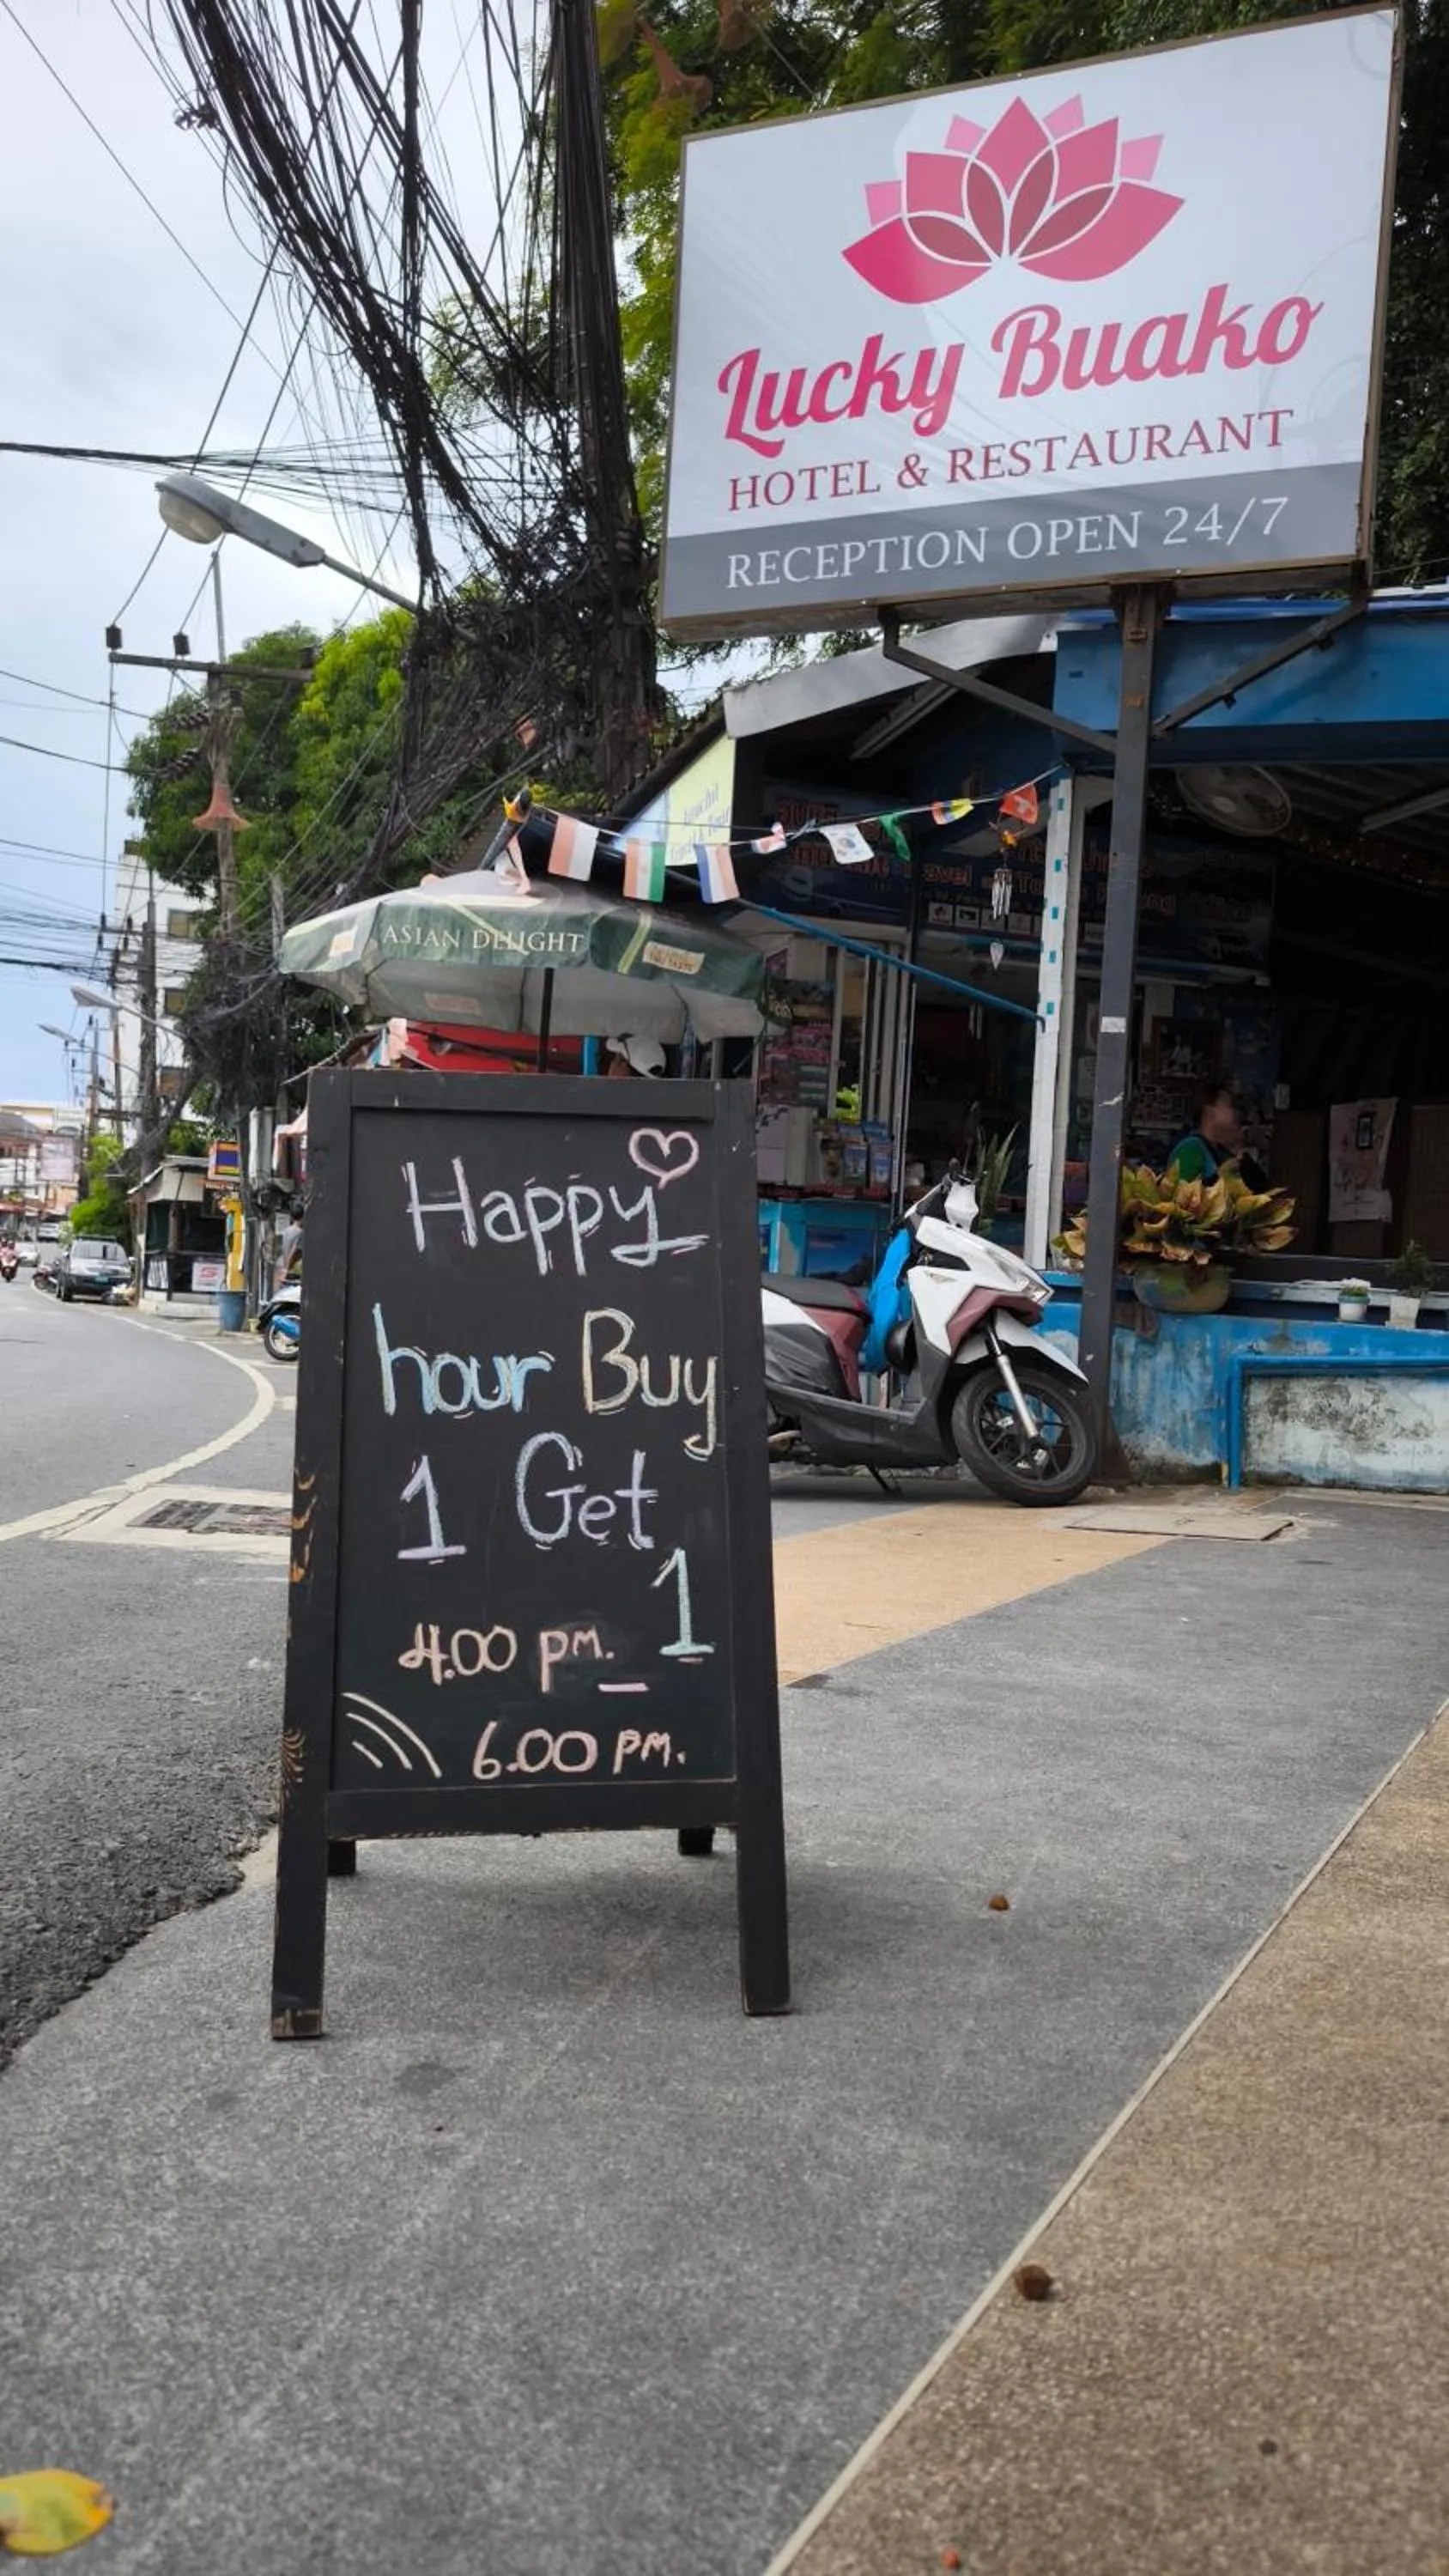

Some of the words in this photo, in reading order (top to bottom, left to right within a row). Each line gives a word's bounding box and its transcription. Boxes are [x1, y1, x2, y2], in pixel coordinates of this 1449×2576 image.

[717, 333, 965, 458] Lucky
[991, 283, 1325, 399] Buako
[728, 461, 881, 511] HOTEL
[897, 453, 928, 489] &
[948, 409, 1294, 483] RESTAURANT
[726, 526, 989, 589] RECEPTION
[1007, 510, 1143, 559] OPEN
[1163, 495, 1288, 546] 24/7
[383, 925, 460, 948] ASIAN
[473, 929, 585, 953] DELIGHT
[401, 1155, 710, 1276] Happy
[373, 1303, 555, 1419] hour
[580, 1307, 718, 1461] Buy
[397, 1455, 466, 1564] 1
[516, 1431, 658, 1551] Get
[398, 1623, 518, 1686] 4.00
[651, 1548, 715, 1662] 1
[474, 1721, 598, 1780] 6.00
